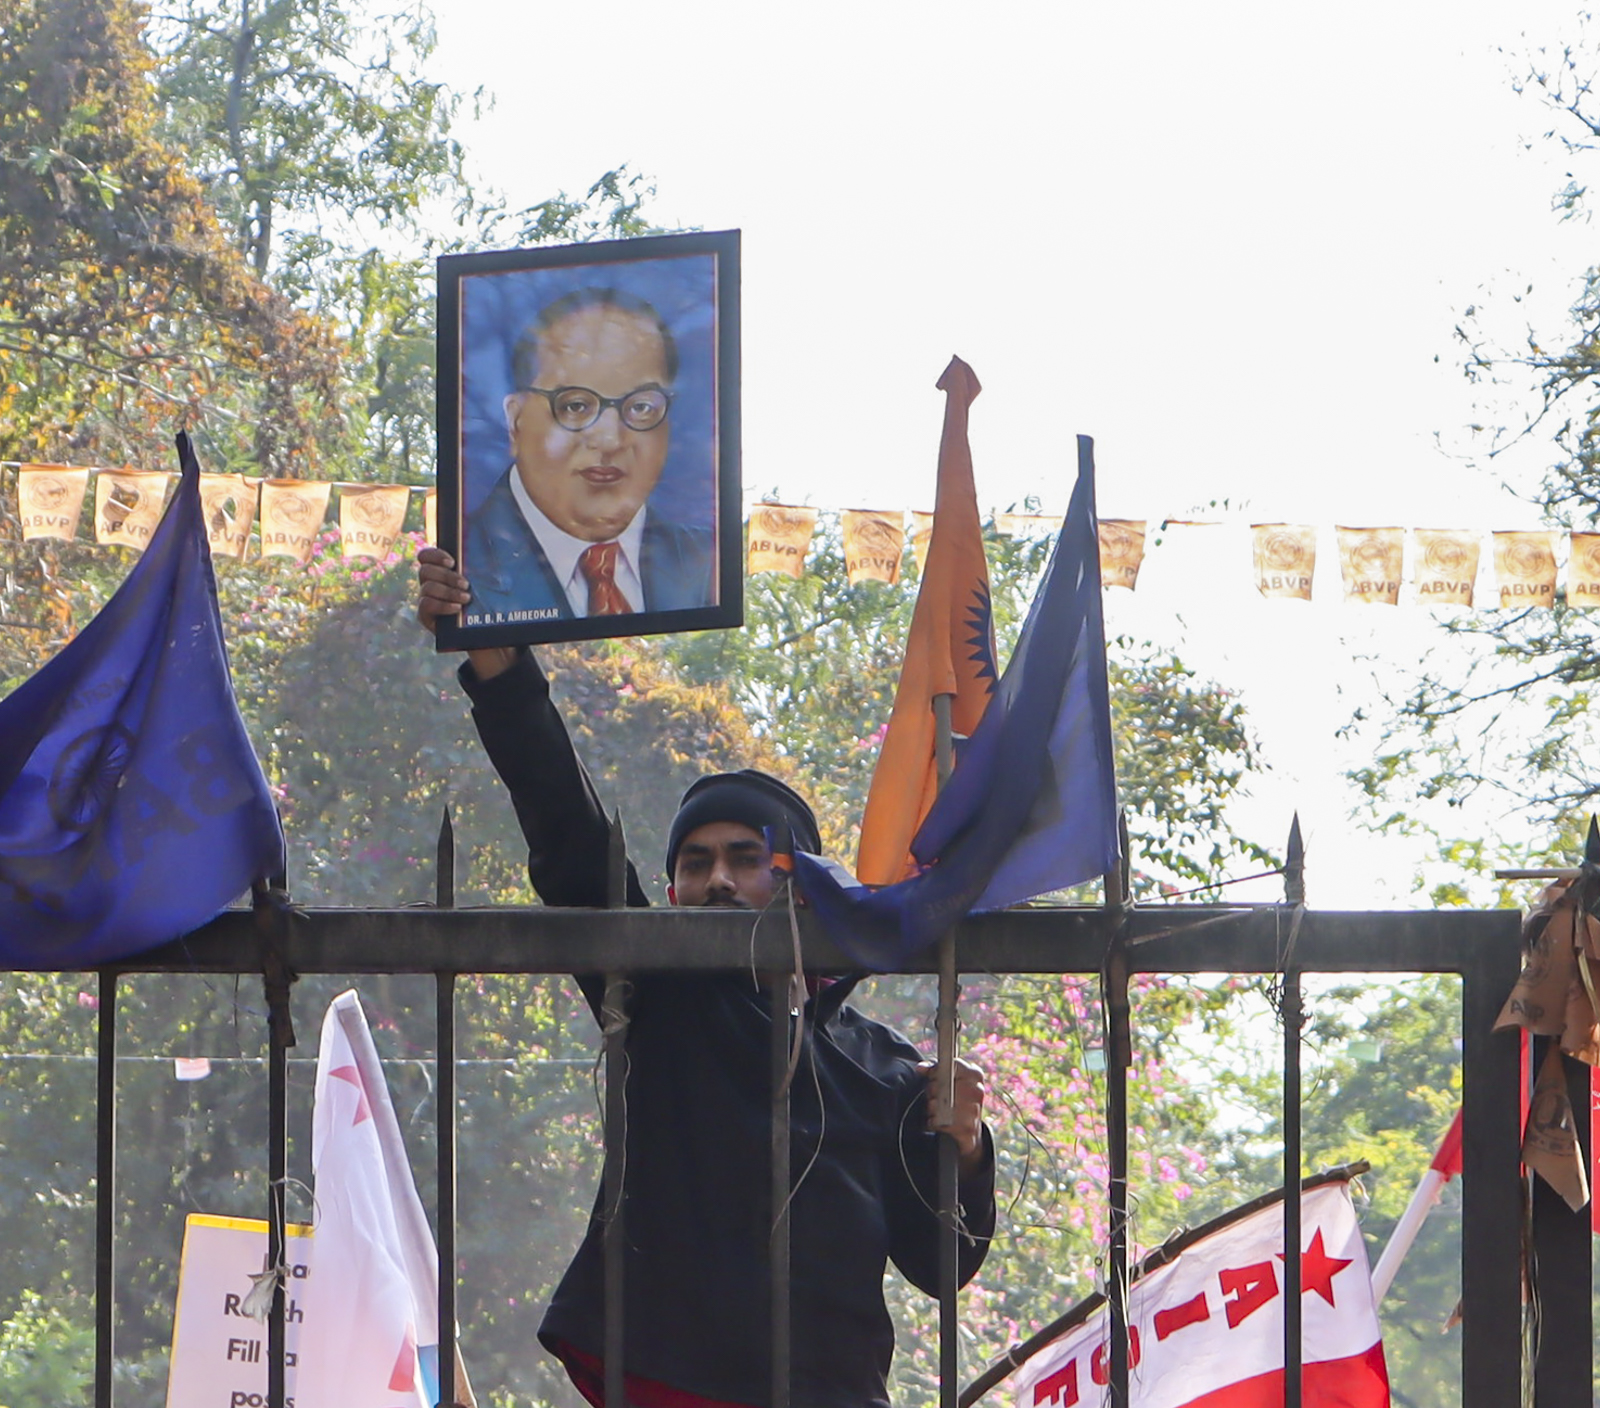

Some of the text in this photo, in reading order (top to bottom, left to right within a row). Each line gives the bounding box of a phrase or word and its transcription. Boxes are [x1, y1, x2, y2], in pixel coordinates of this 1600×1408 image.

[750, 541, 798, 557] ABVP
[1420, 581, 1471, 596] ABVP
[1501, 583, 1550, 597] ABVP
